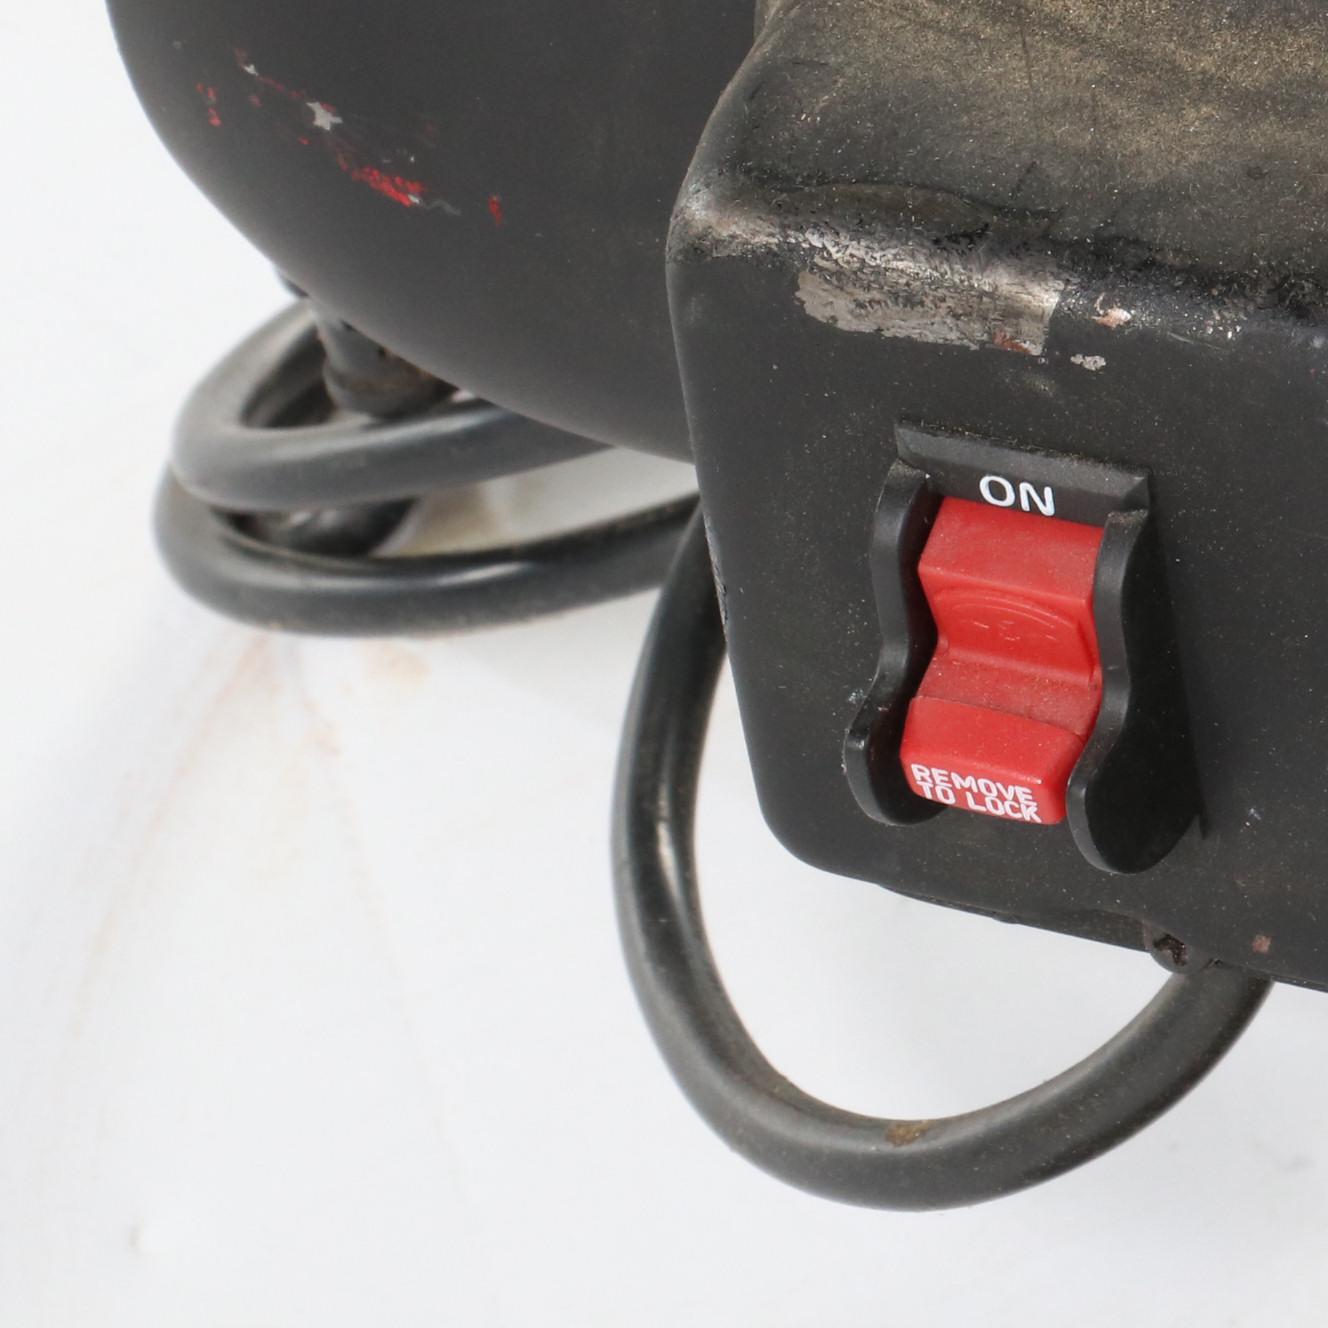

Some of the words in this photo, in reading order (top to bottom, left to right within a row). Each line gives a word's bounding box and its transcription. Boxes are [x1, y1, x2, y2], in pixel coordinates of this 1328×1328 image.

[979, 475, 1056, 517] ON
[911, 764, 1037, 806] REMOVE
[917, 781, 955, 805] TO
[966, 791, 1042, 823] LOCK
